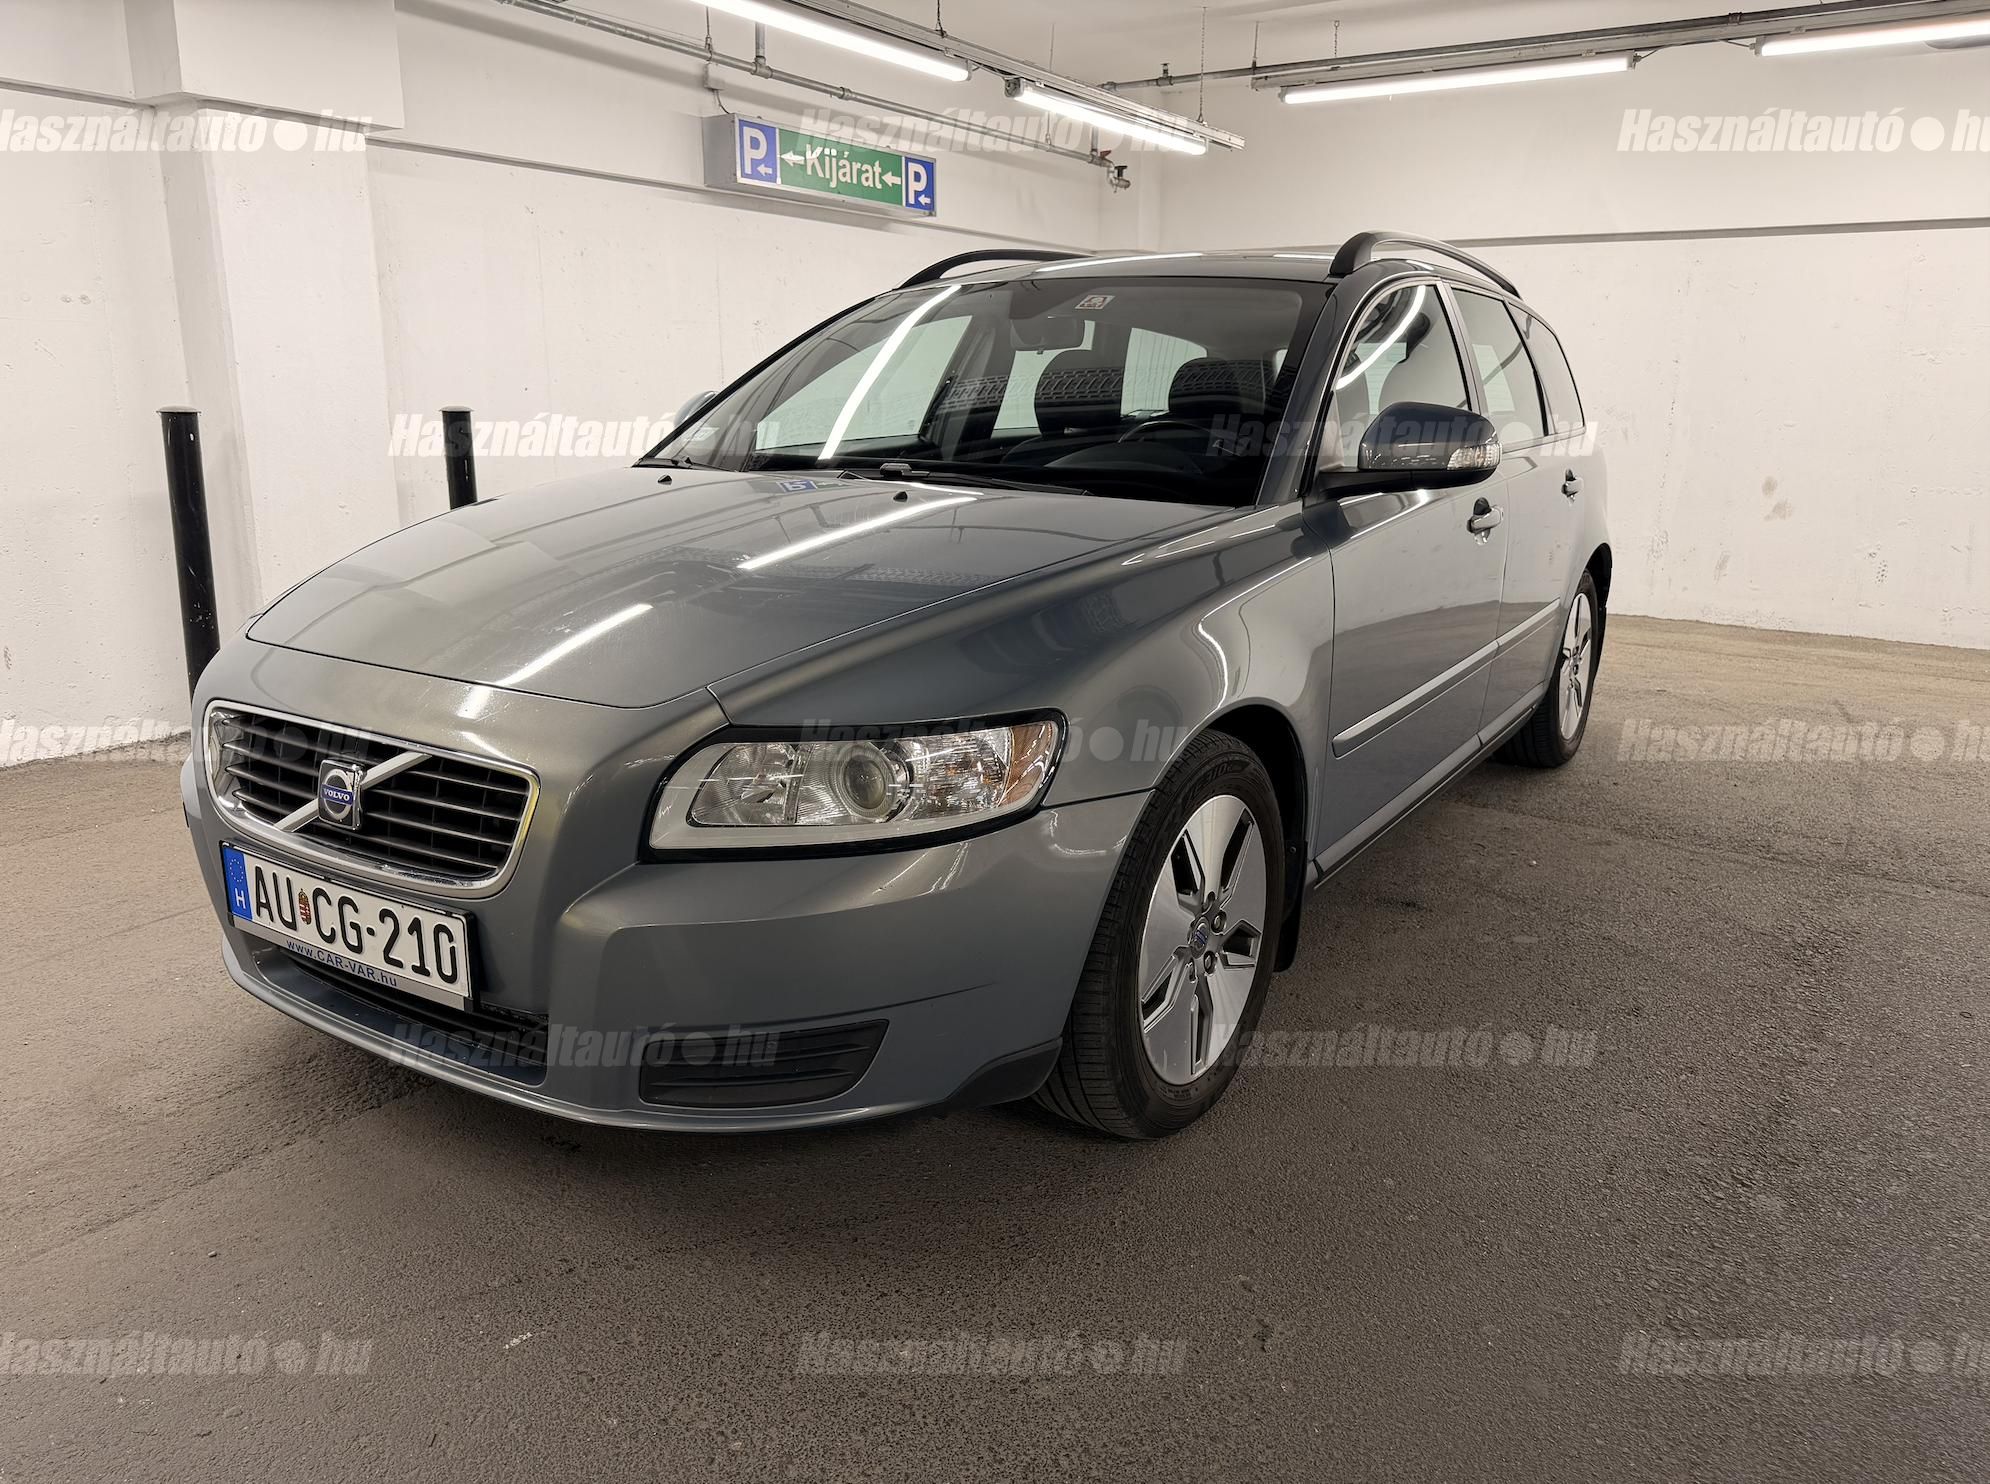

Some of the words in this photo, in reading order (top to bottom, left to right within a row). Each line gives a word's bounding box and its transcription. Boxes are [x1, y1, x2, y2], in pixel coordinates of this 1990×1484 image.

[743, 126, 768, 175] P
[806, 143, 882, 189] Kijárat
[907, 161, 928, 205] P
[323, 788, 350, 801] VOLVO
[234, 887, 246, 910] H
[255, 865, 297, 931] AU
[312, 887, 458, 984] CG-210
[286, 939, 397, 987] www.CAR-VAR.hu
